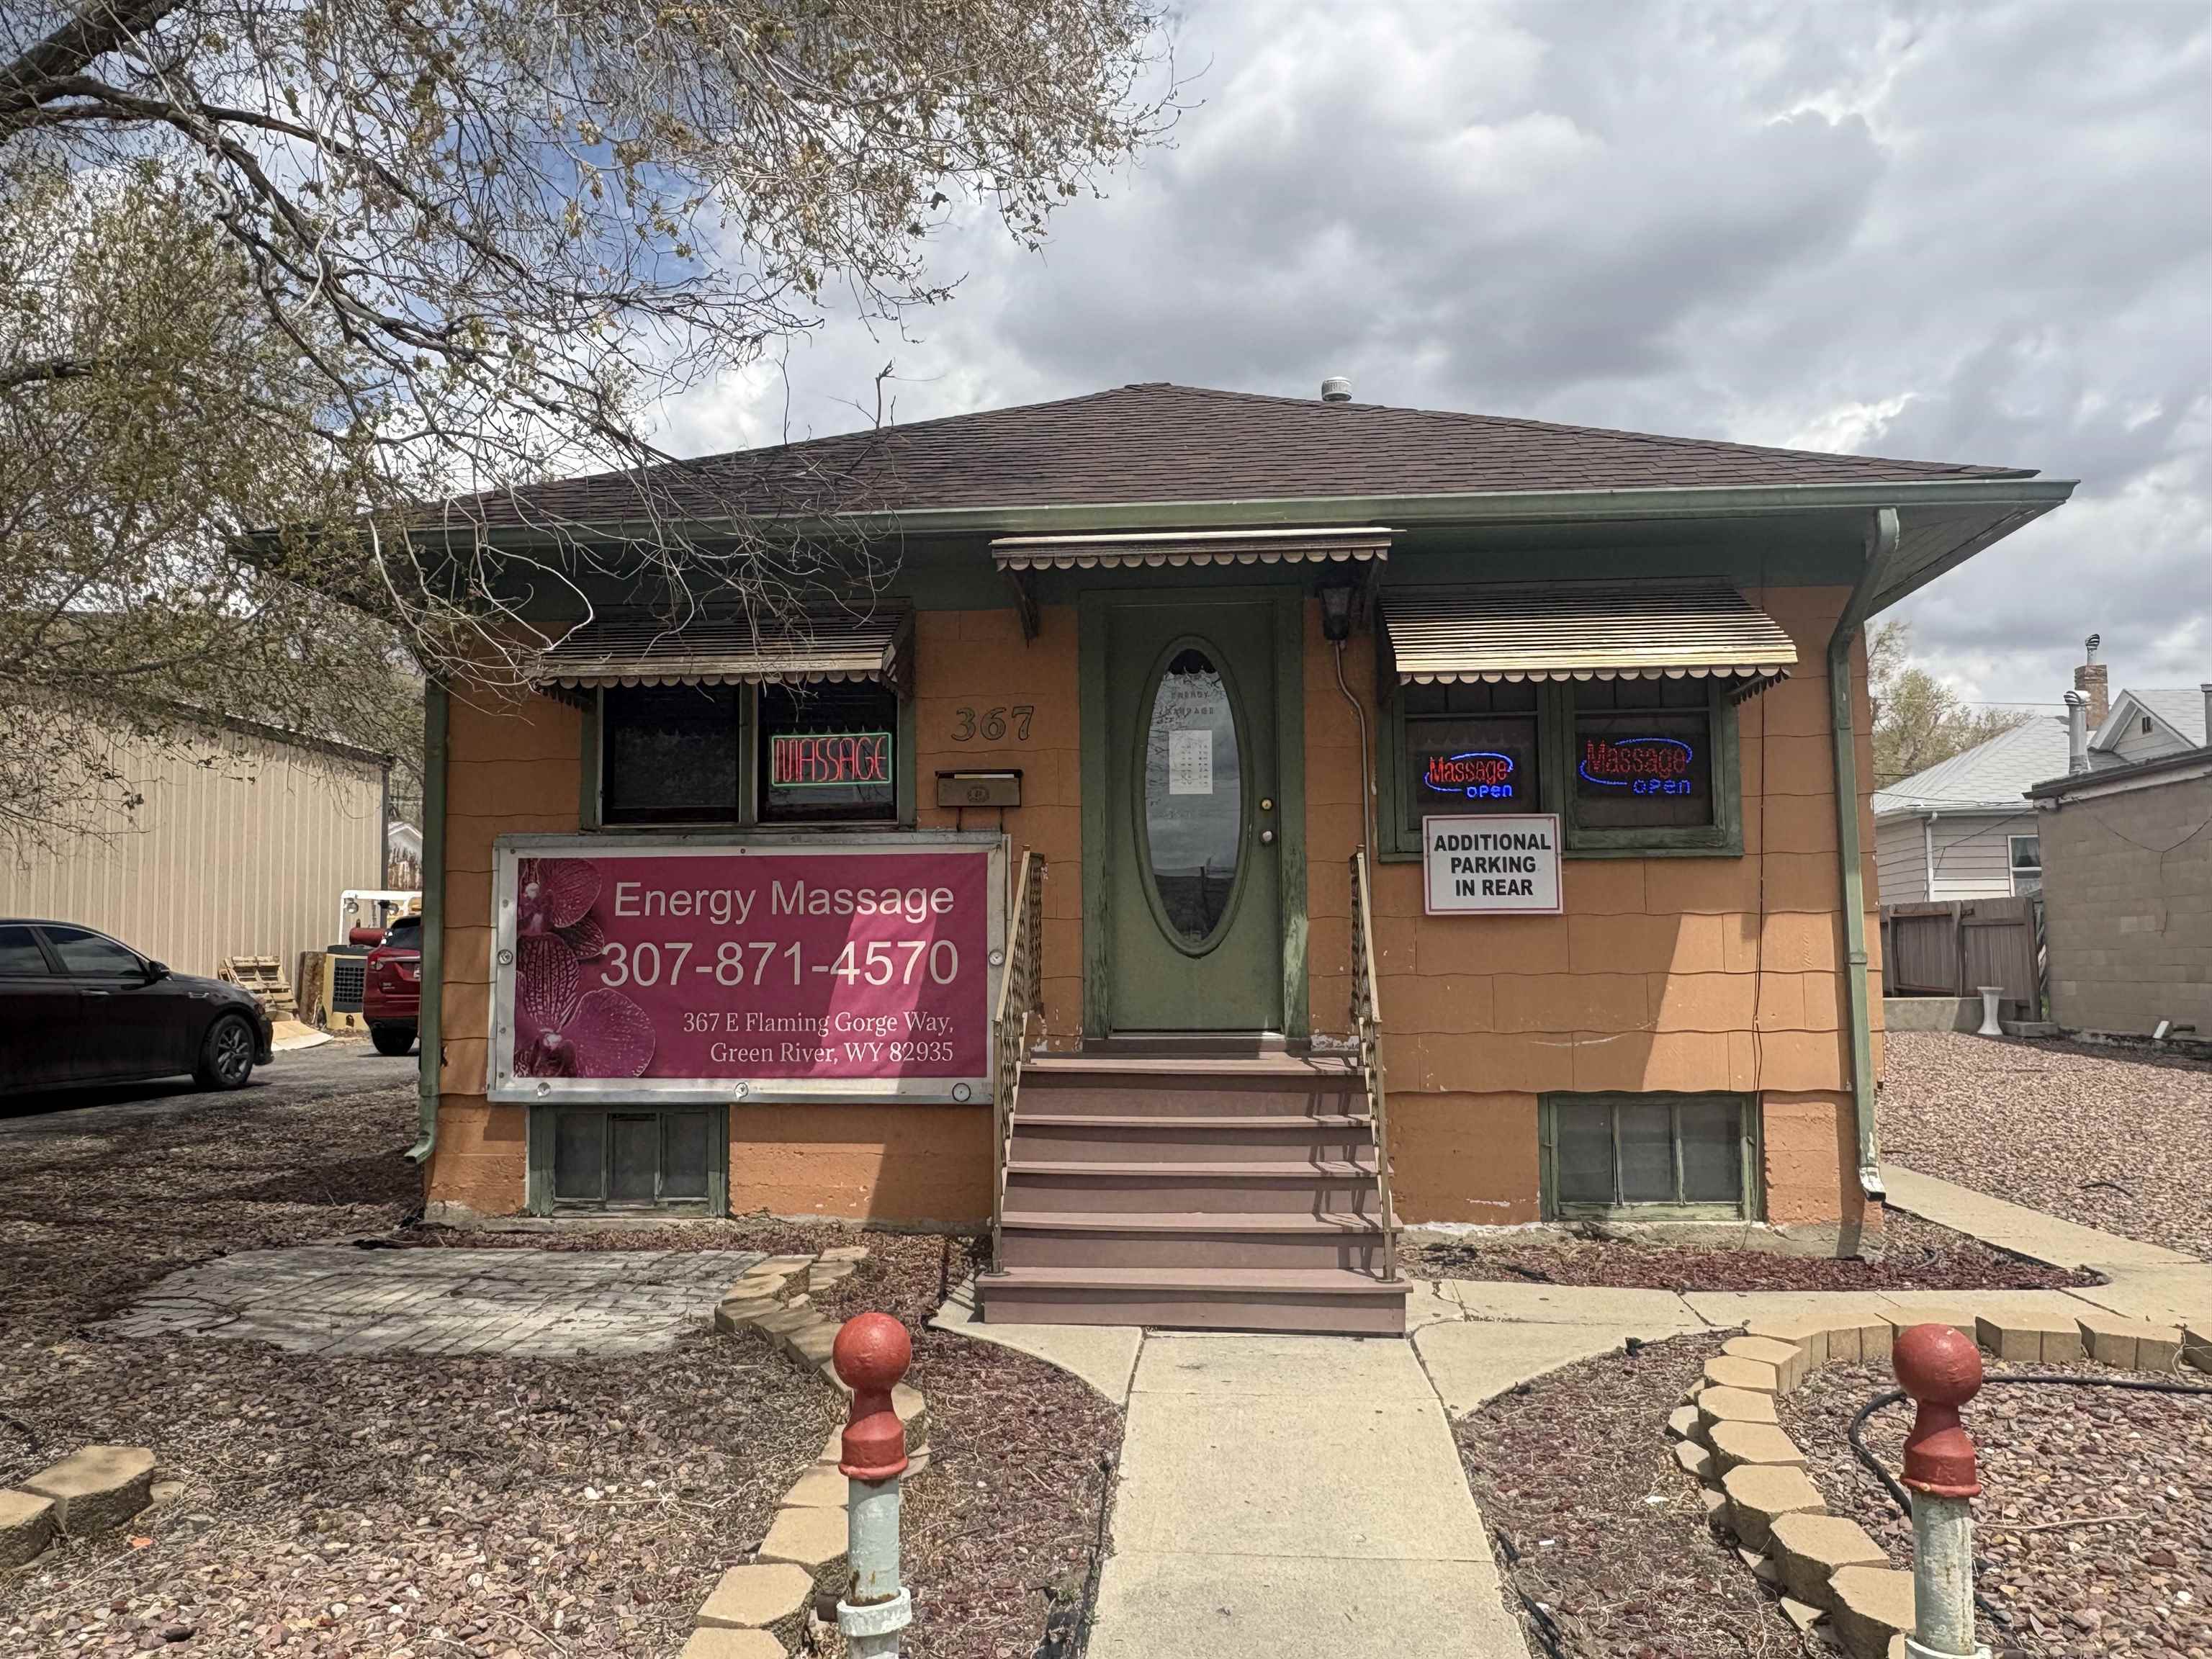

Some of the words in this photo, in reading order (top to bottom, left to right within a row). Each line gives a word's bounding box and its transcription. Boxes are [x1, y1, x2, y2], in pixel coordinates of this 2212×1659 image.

[950, 705, 1035, 741] 367
[775, 737, 888, 782] MASSAGE
[1429, 756, 1508, 784] Massage
[1586, 739, 1686, 778] Massage
[1434, 833, 1551, 852] ADDITIONAL
[1451, 856, 1536, 874] PARKING
[1455, 879, 1475, 896] IN
[1482, 878, 1534, 896] REAR
[615, 881, 756, 925] Energy
[771, 880, 955, 925] Massage
[600, 940, 959, 987] 307-871-4570
[683, 1012, 720, 1033] 367
[725, 1012, 739, 1033] E
[745, 1011, 830, 1038] Flaming
[834, 1011, 899, 1038] Gorge
[902, 1010, 954, 1036] Way,
[710, 1042, 773, 1063] Green
[780, 1041, 838, 1066] River,
[843, 1041, 884, 1063] WY
[889, 1041, 953, 1062] 82935
